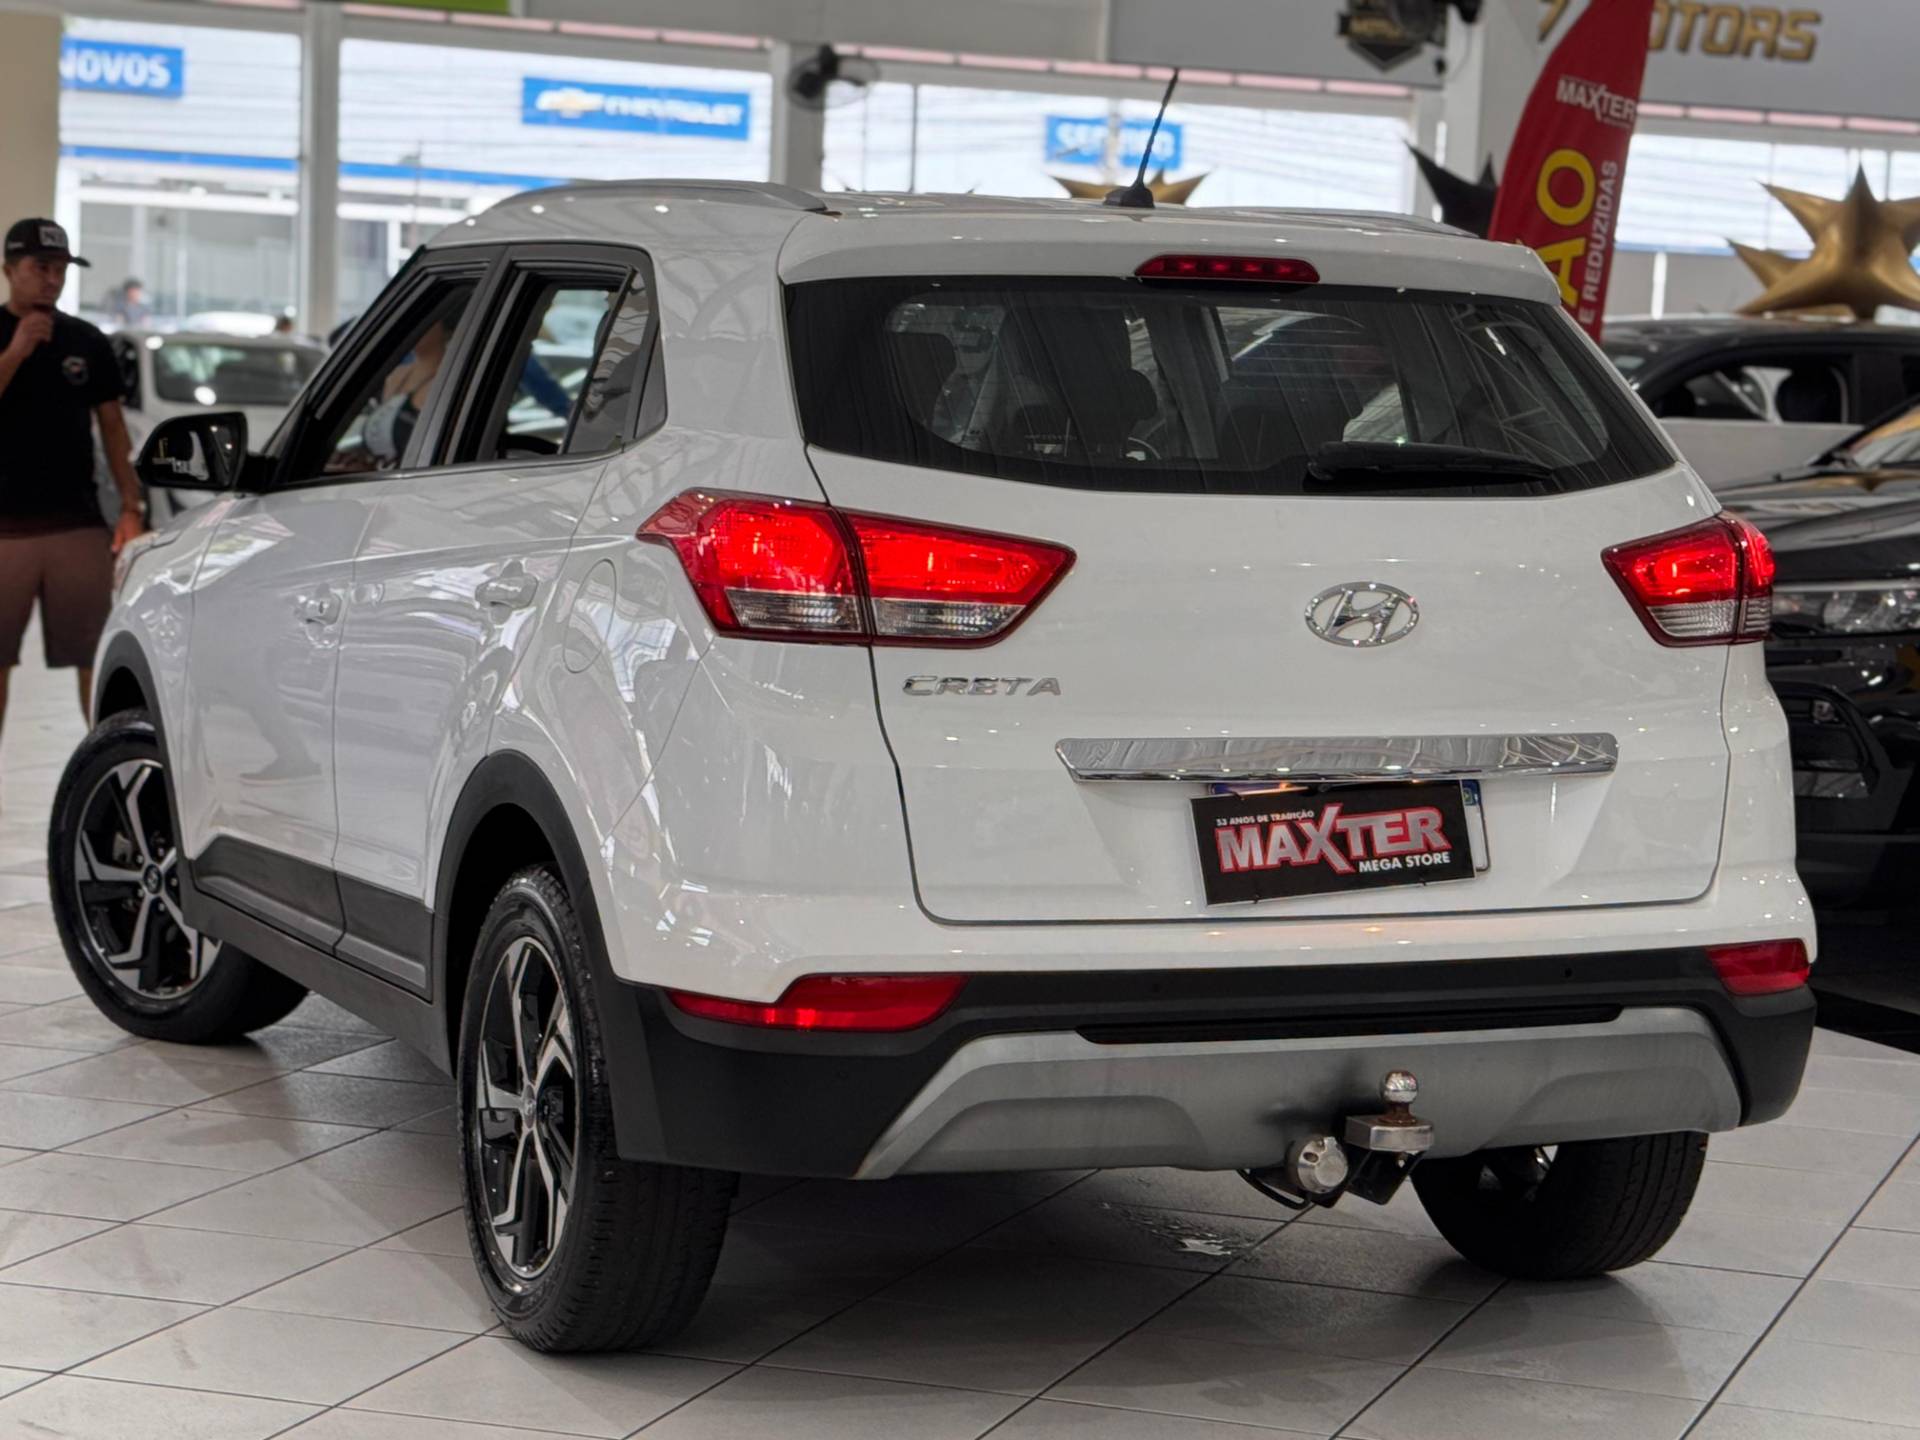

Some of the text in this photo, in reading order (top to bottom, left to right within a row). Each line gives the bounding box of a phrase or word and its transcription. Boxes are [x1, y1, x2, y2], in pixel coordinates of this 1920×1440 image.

[1649, 3, 1821, 61] OTORS
[1556, 79, 1637, 123] MAXTER
[1582, 160, 1618, 301] REDUZIDAS
[902, 675, 1062, 696] CRETA
[1215, 802, 1452, 874] MAXTER
[1229, 815, 1256, 826] ANOS
[1257, 814, 1269, 823] DE
[1270, 809, 1315, 822] TRADIÇÃO
[1358, 851, 1451, 874] MEGA STORE
